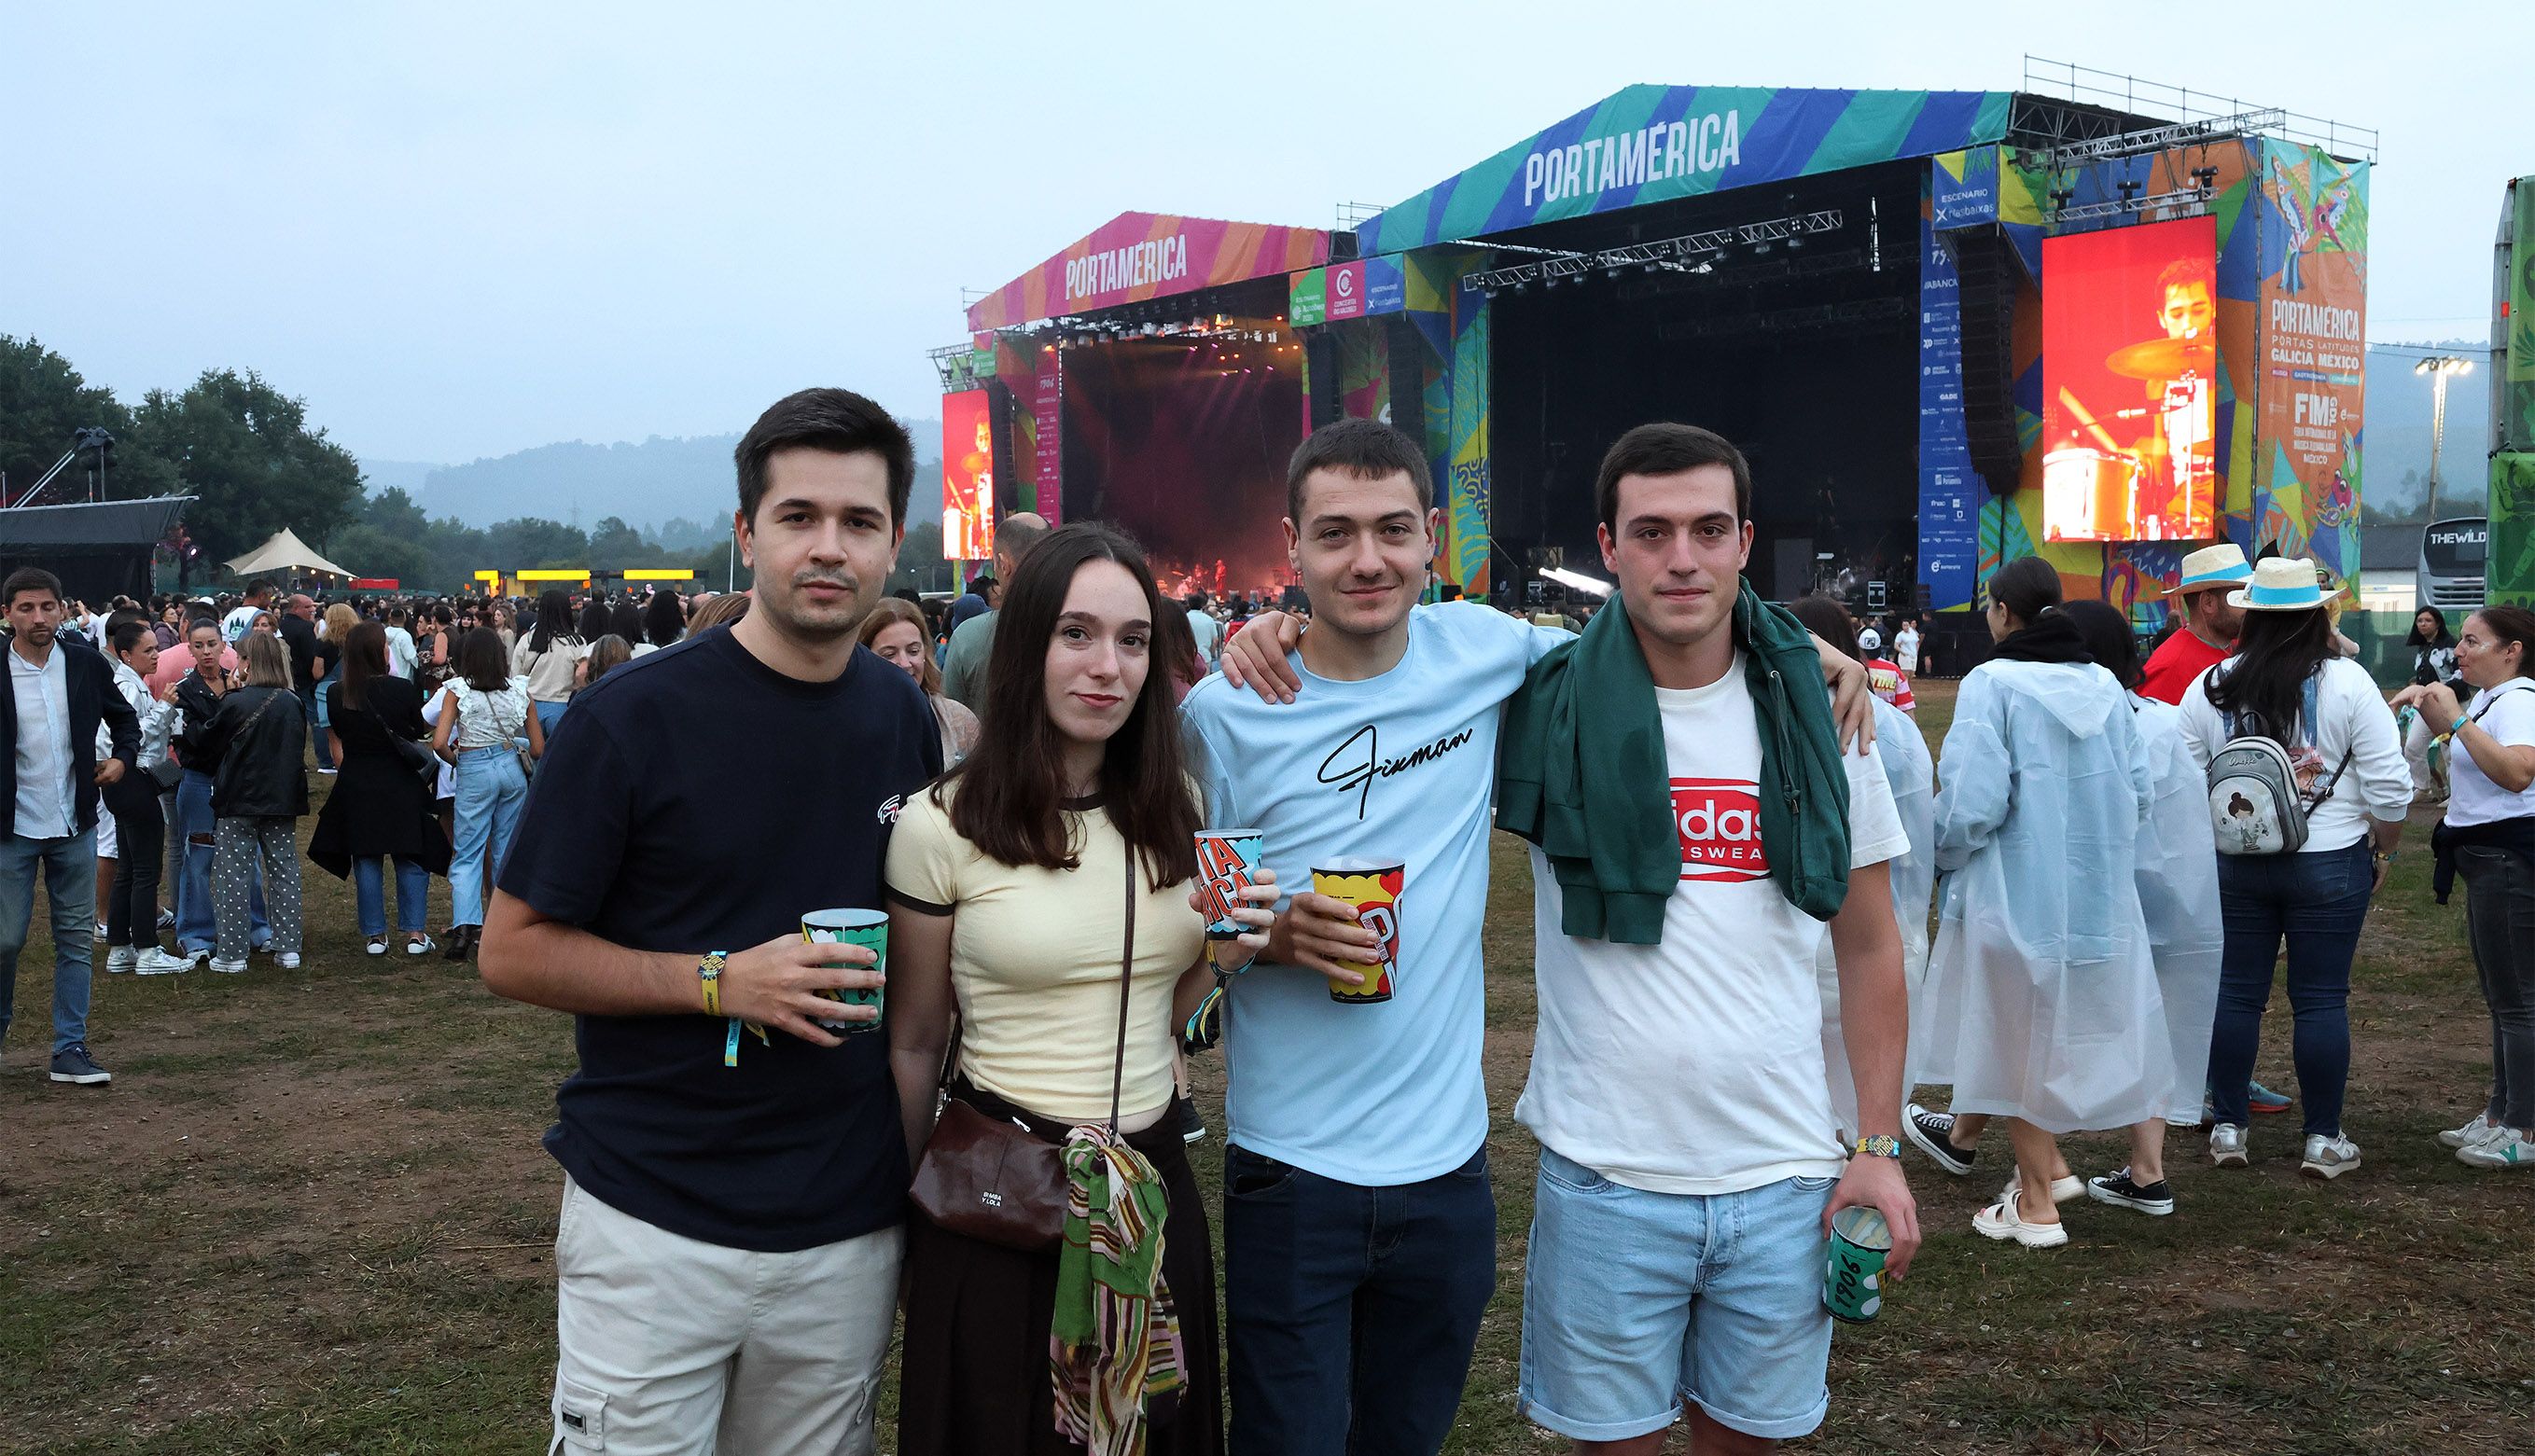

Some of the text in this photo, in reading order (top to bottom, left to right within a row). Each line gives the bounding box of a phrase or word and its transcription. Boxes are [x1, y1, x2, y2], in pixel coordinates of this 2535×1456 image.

[1525, 109, 1740, 207] PORTAMÉRICA
[1941, 188, 1988, 203] ESCENARIO
[1066, 233, 1187, 300] PORTAMÉRICA
[2272, 298, 2360, 341] PORTAMÉRICA
[2271, 347, 2360, 369] GALICIA MÉXICO
[2272, 335, 2360, 354] PORTAS LATITUDES
[2295, 393, 2329, 426] FIM
[1835, 1254, 1861, 1308] 1906
